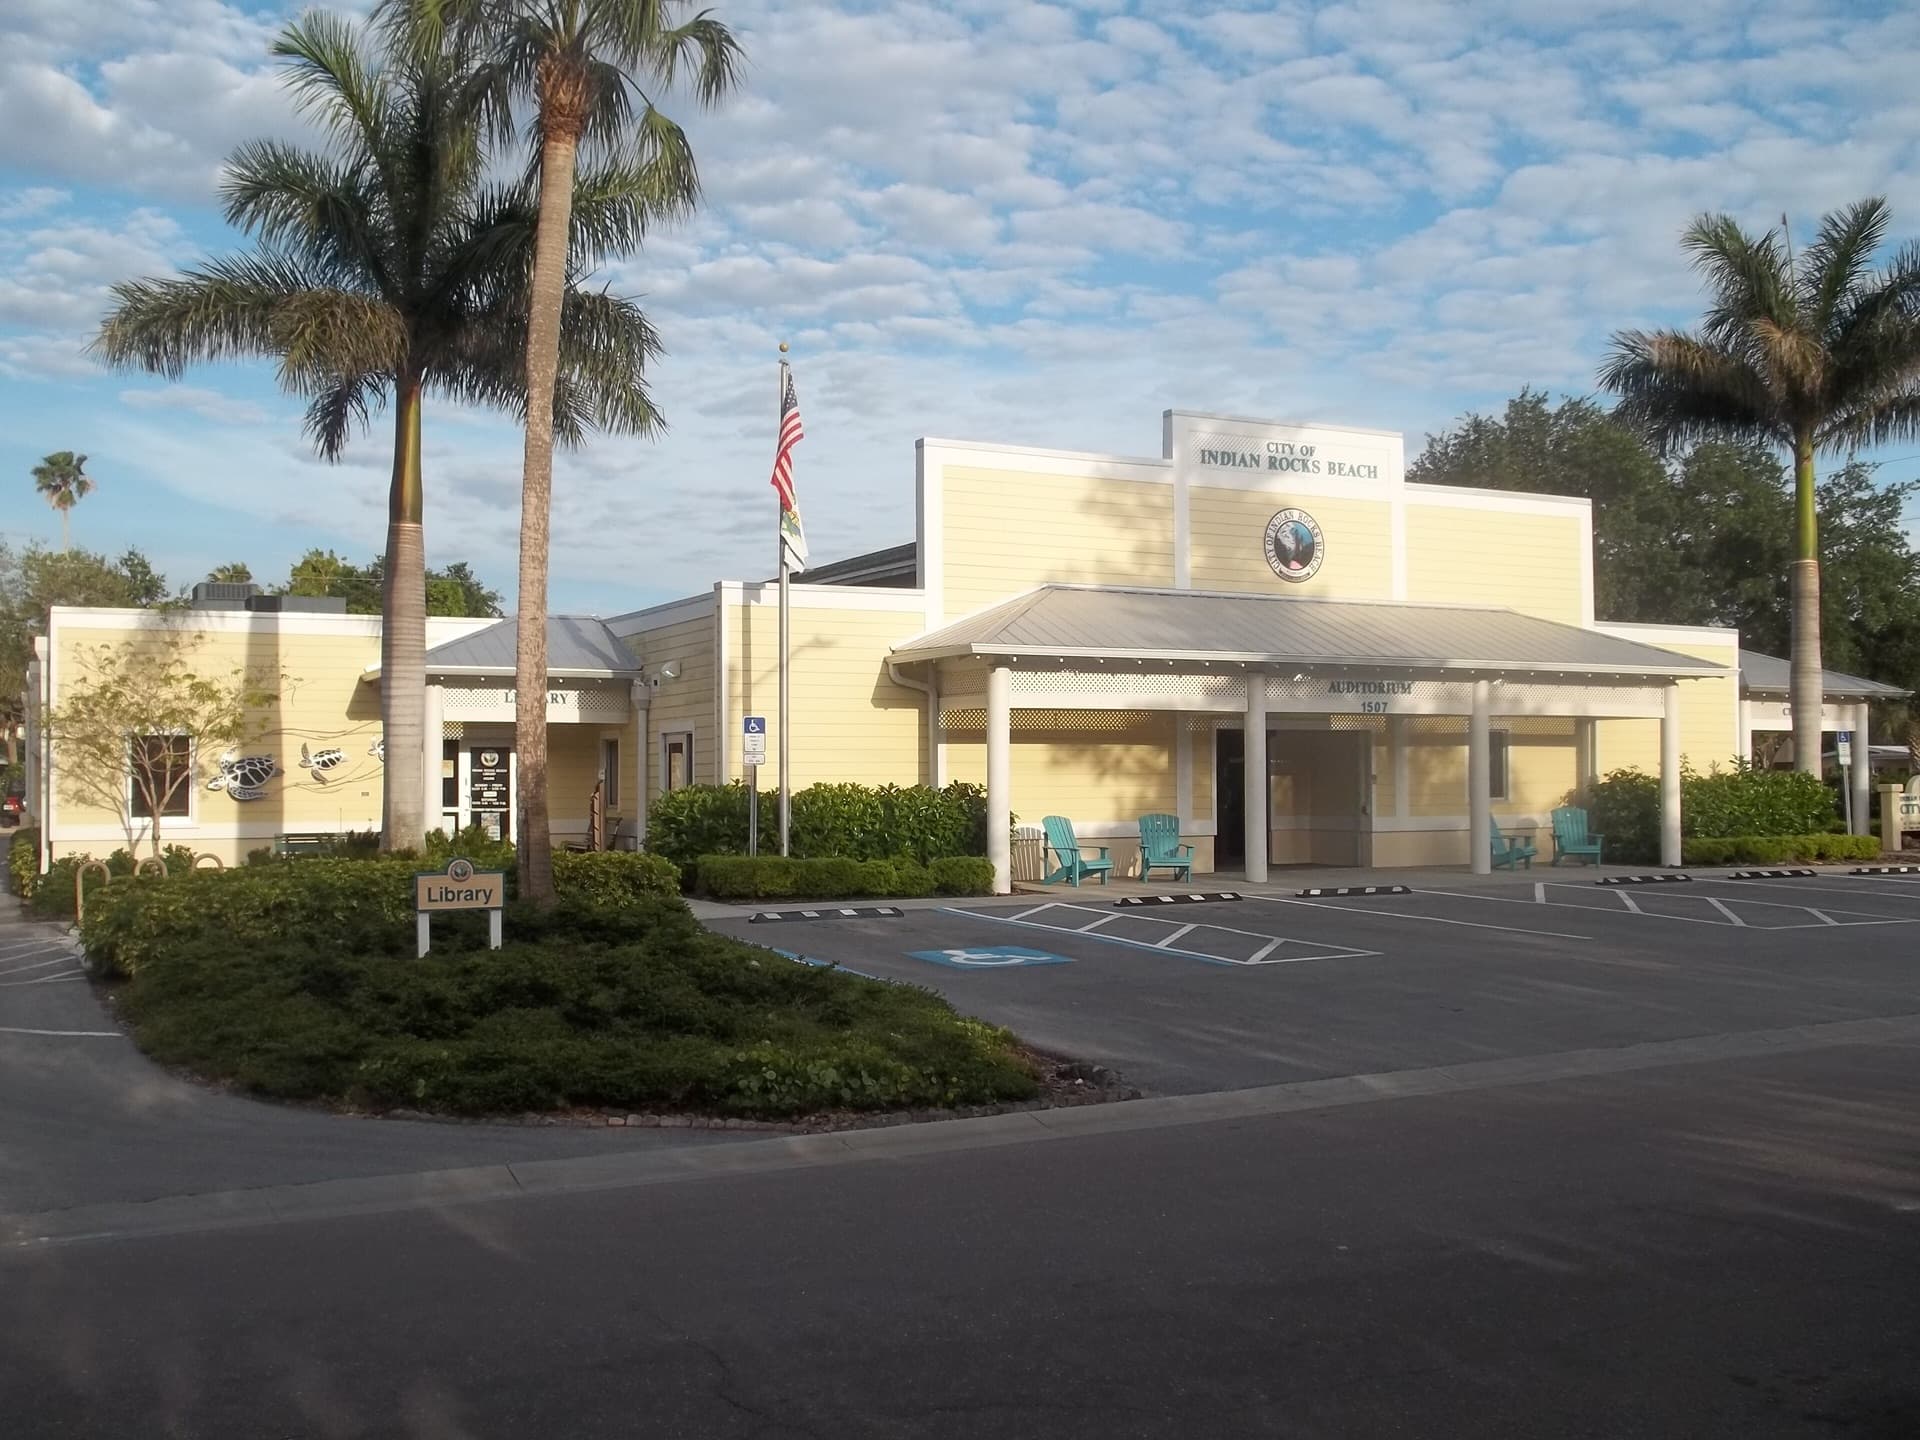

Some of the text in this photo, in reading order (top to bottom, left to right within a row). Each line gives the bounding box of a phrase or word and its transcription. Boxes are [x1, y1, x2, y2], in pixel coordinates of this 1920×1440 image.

[1266, 442, 1316, 457] CITY OF
[1200, 449, 1378, 479] INDIAN ROCKS BEACH
[1266, 511, 1323, 572] CITY OF INDIAN ROCKS BEACH
[1327, 681, 1414, 695] AUDITORIUM
[504, 692, 569, 704] LIRY
[1361, 702, 1388, 713] 1507
[427, 886, 493, 905] Library
